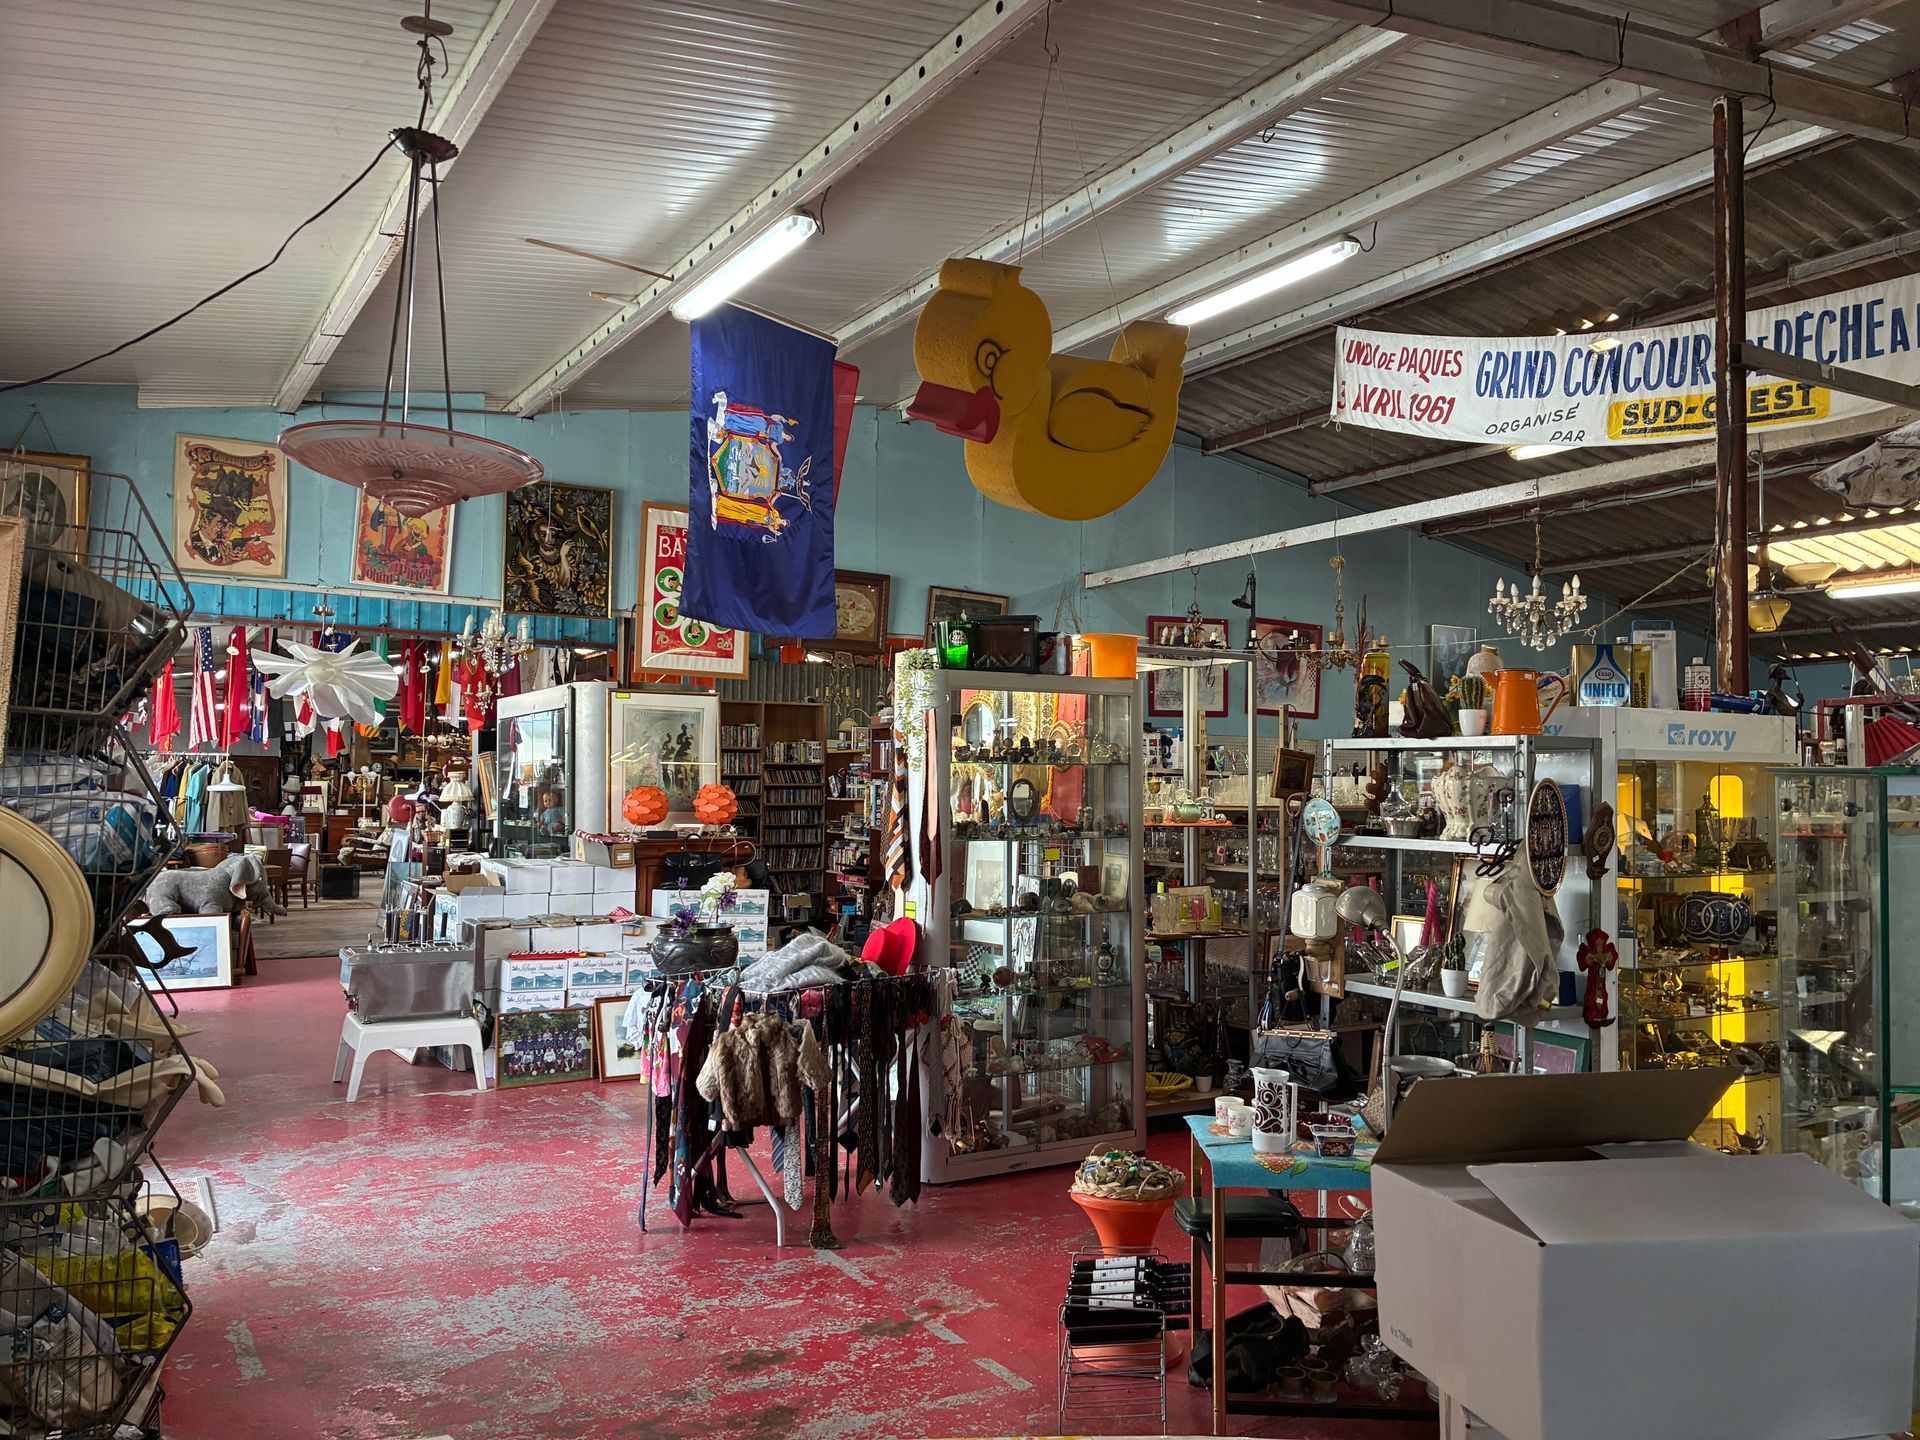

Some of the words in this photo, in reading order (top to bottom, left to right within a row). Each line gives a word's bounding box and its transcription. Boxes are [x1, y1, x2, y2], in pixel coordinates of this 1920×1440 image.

[1377, 352, 1396, 371] DE
[1397, 346, 1464, 383] PAQUES
[1475, 350, 1557, 399] GRAND
[1563, 333, 1717, 398] CONCOUR
[1336, 380, 1347, 410] 3
[1352, 384, 1406, 420] AVRIL
[1408, 393, 1456, 425] 1961
[1485, 402, 1580, 436] ORGANISÉ
[1622, 383, 1816, 427] SUD-OEST
[1548, 430, 1586, 443] PAR
[1584, 683, 1625, 698] UNIFLO
[1543, 724, 1564, 736] xy
[1687, 730, 1736, 751] roxy
